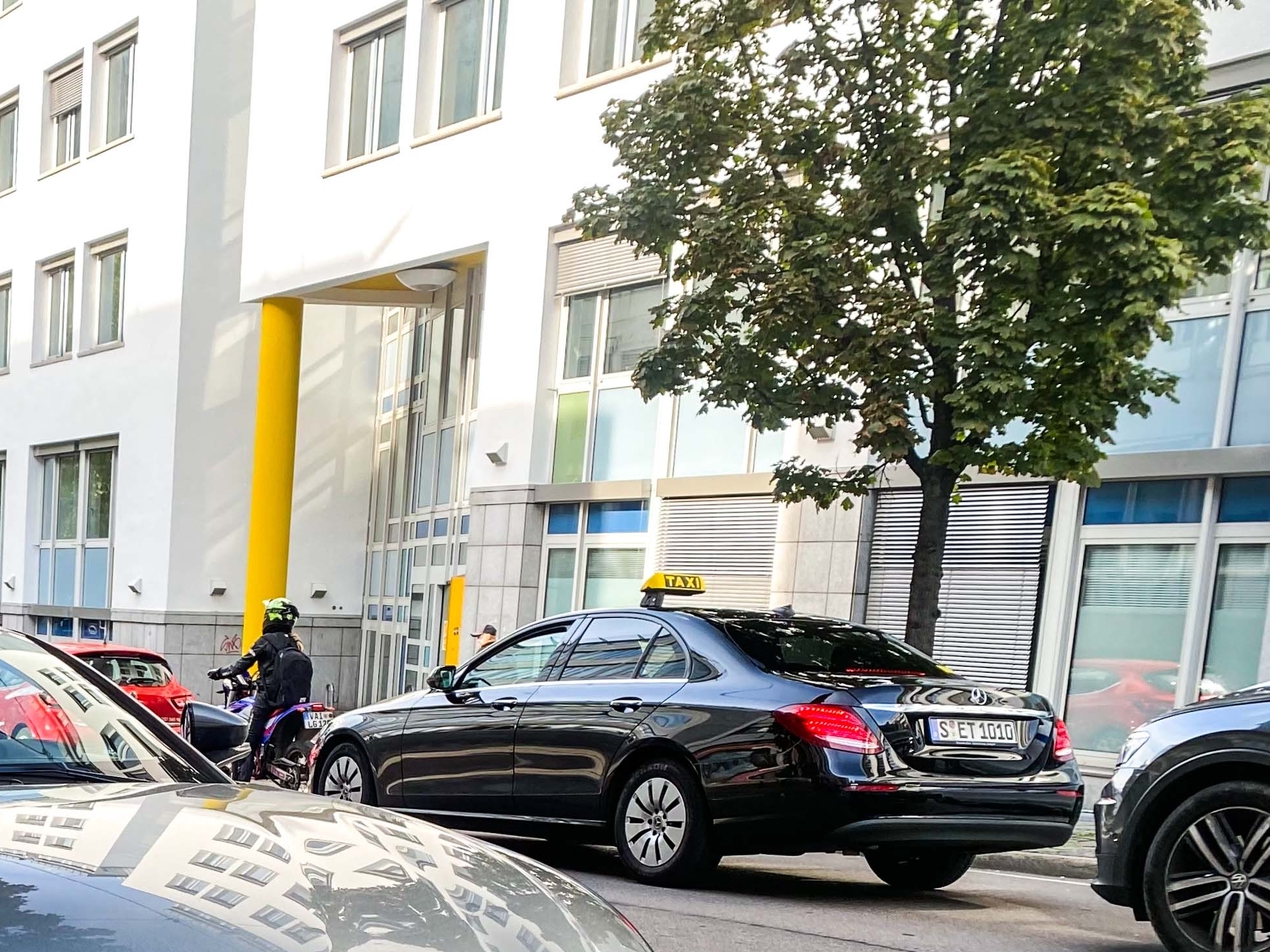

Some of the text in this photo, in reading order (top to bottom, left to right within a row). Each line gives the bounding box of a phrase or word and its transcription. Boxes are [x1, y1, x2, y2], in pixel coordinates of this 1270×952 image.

[665, 575, 700, 589] TAXI
[938, 720, 1014, 740] S ET 1010
